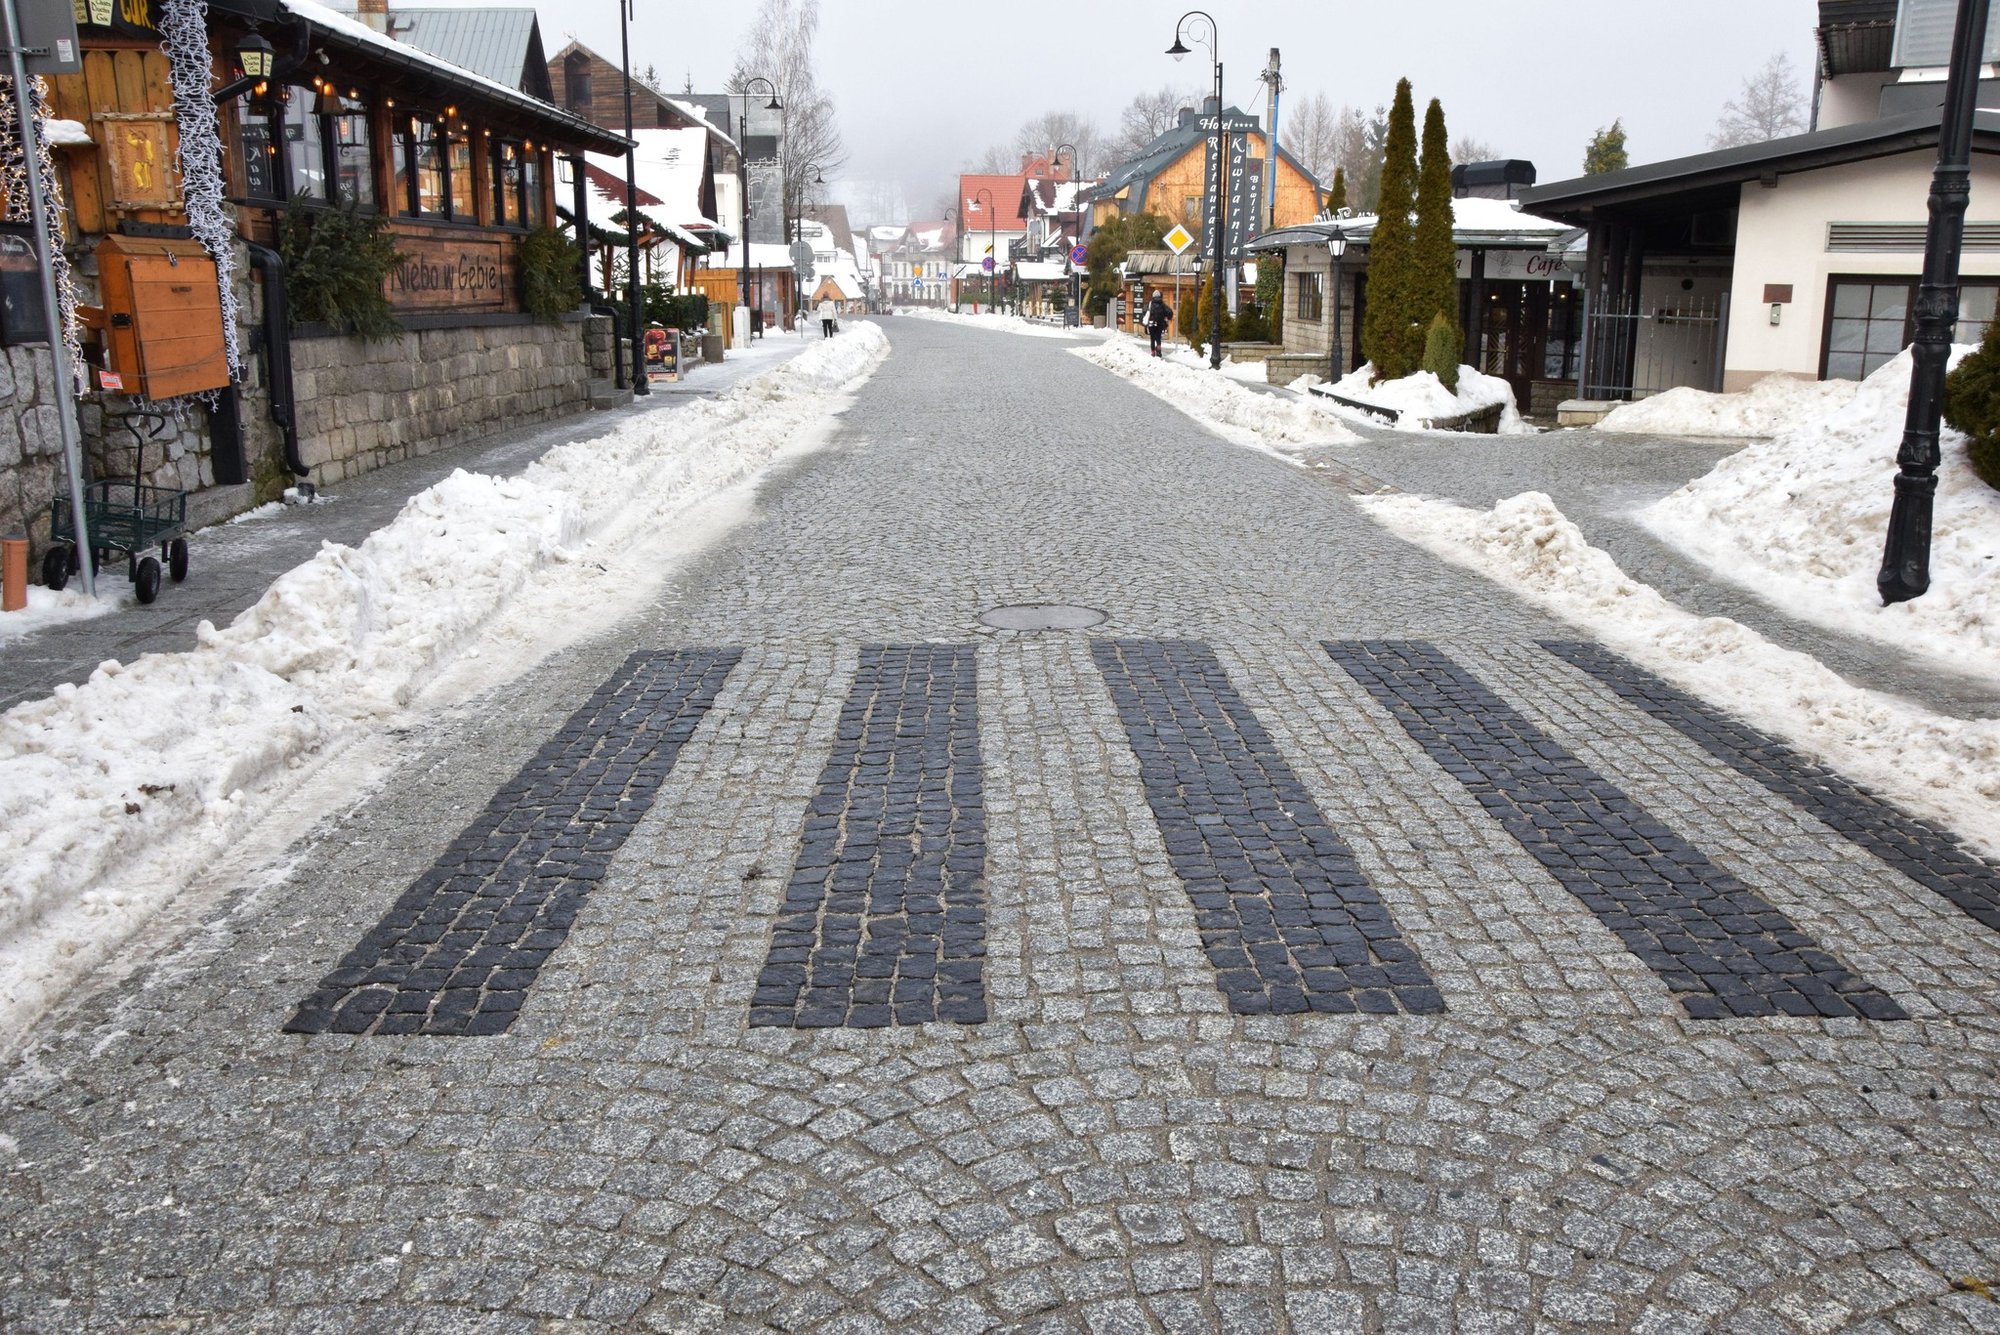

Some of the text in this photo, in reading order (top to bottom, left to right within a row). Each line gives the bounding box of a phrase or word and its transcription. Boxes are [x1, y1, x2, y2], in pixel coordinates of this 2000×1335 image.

[1199, 117, 1233, 130] Hoel
[1206, 137, 1218, 256] Restauracja
[1230, 138, 1245, 255] Kawiarnia
[1249, 176, 1259, 231] Bowling
[391, 253, 497, 298] Niebo w Gębie
